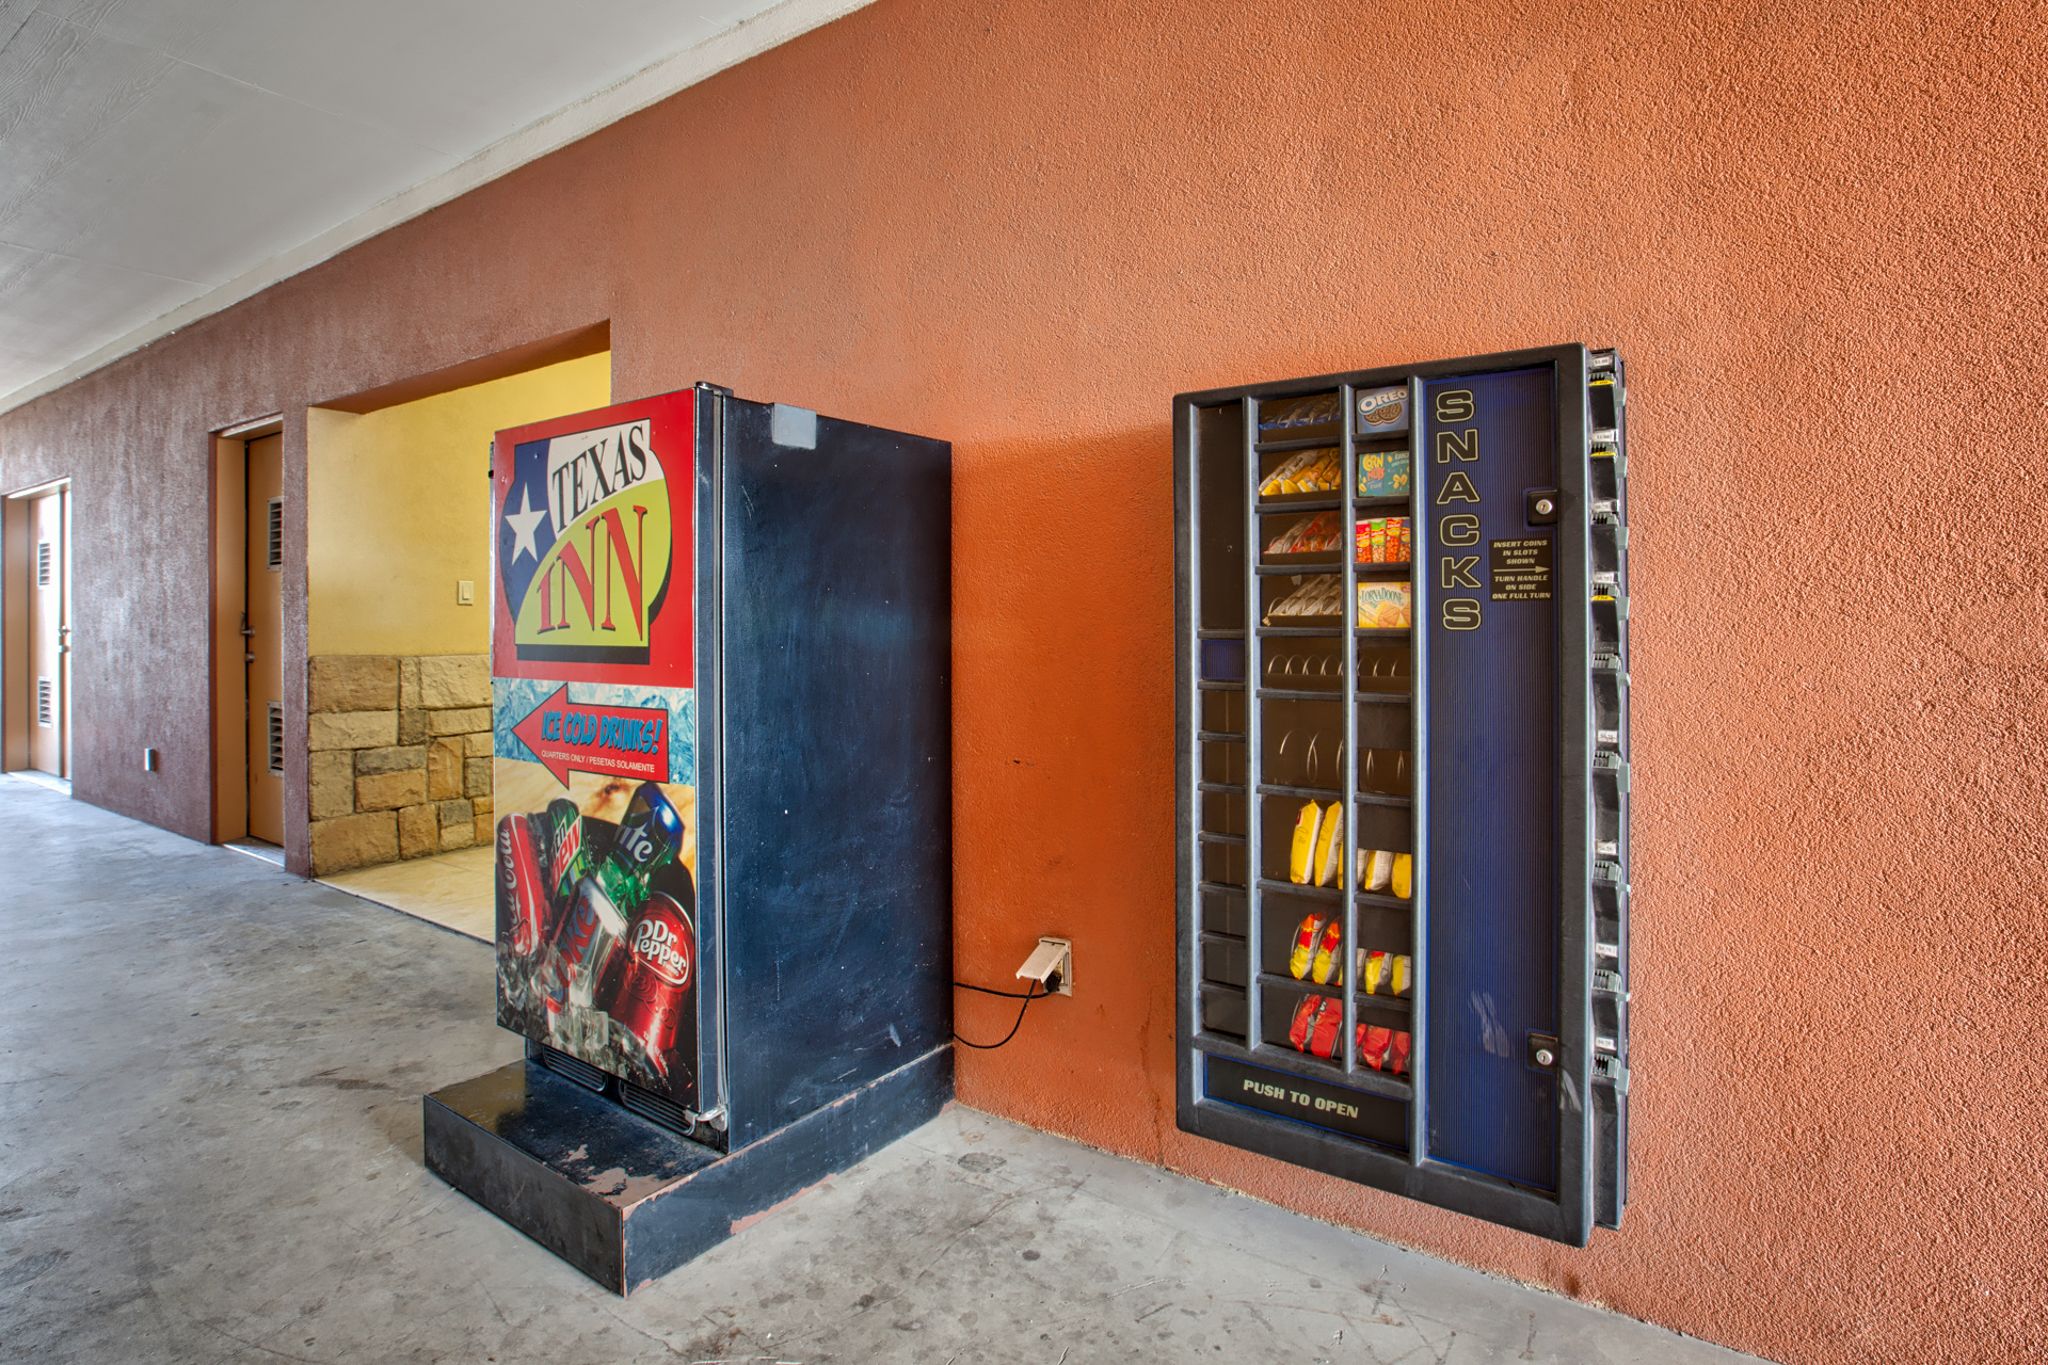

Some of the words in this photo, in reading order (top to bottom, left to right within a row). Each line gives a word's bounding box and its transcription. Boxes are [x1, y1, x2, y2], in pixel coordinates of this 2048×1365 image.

[1359, 390, 1409, 413] OREO
[552, 423, 648, 534] TEXAS
[1436, 389, 1482, 632] SNACKS
[1493, 540, 1521, 548] INSERT
[536, 504, 648, 642] INN
[541, 710, 562, 743] ICE
[563, 711, 597, 747] COLD
[599, 714, 663, 755] DRINKS!
[541, 750, 570, 761] QUARTERS
[571, 754, 586, 763] ONLY
[590, 756, 615, 768] PESETAS
[616, 760, 655, 773] SOLAMENTE
[631, 919, 687, 972] Pepper
[652, 919, 678, 947] Dr
[1243, 1079, 1285, 1100] PUSH
[1289, 1090, 1310, 1106] TO
[1314, 1097, 1359, 1119] OPEN
